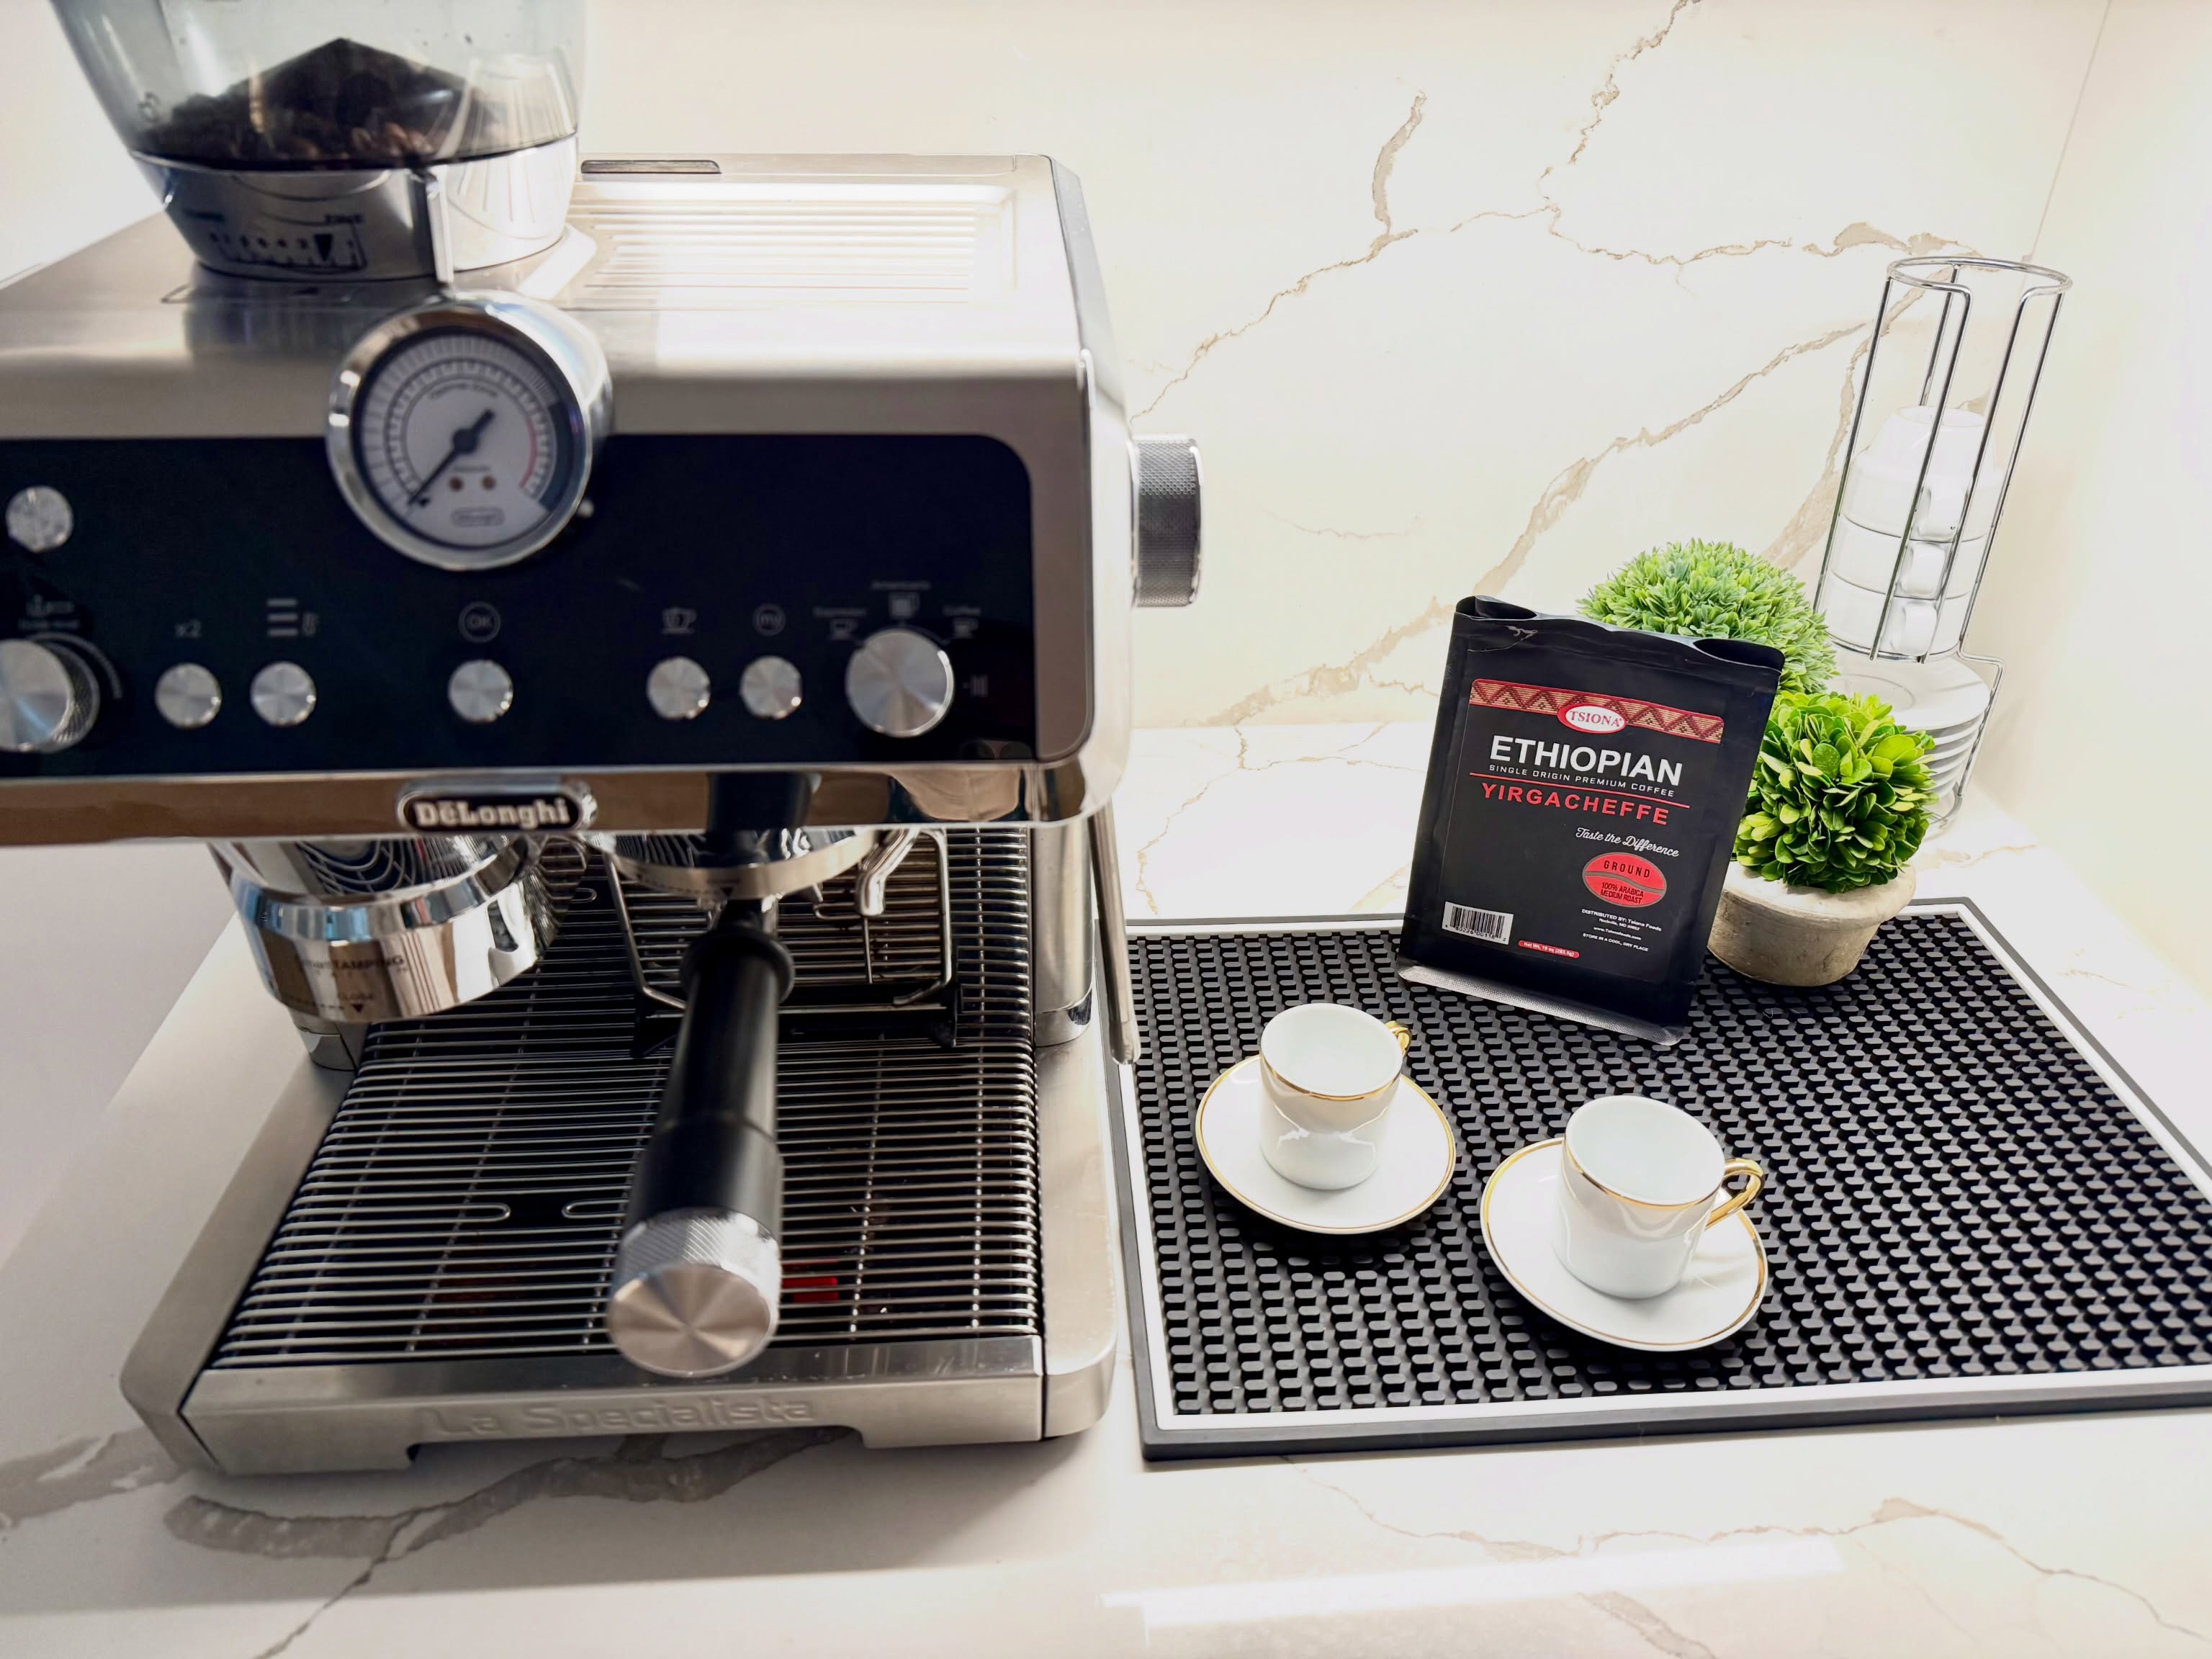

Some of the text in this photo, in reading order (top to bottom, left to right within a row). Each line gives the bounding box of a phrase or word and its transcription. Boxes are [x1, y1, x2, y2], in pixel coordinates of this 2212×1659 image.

[1490, 734, 1683, 786] ETHIOPIAN
[1489, 764, 1675, 797] SINGLE ORIGIN PREMIUM COFFEE
[1482, 783, 1669, 826] YIRGACHEFFE
[1575, 827, 1680, 857] Taste the Difference
[1604, 860, 1650, 878] GROUND
[1600, 889, 1642, 904] MEDIUM ROAST
[1601, 882, 1644, 897] 100% ARABICA
[1581, 909, 1617, 920] DISTRIBUTED
[431, 1395, 817, 1437] La Specialista
